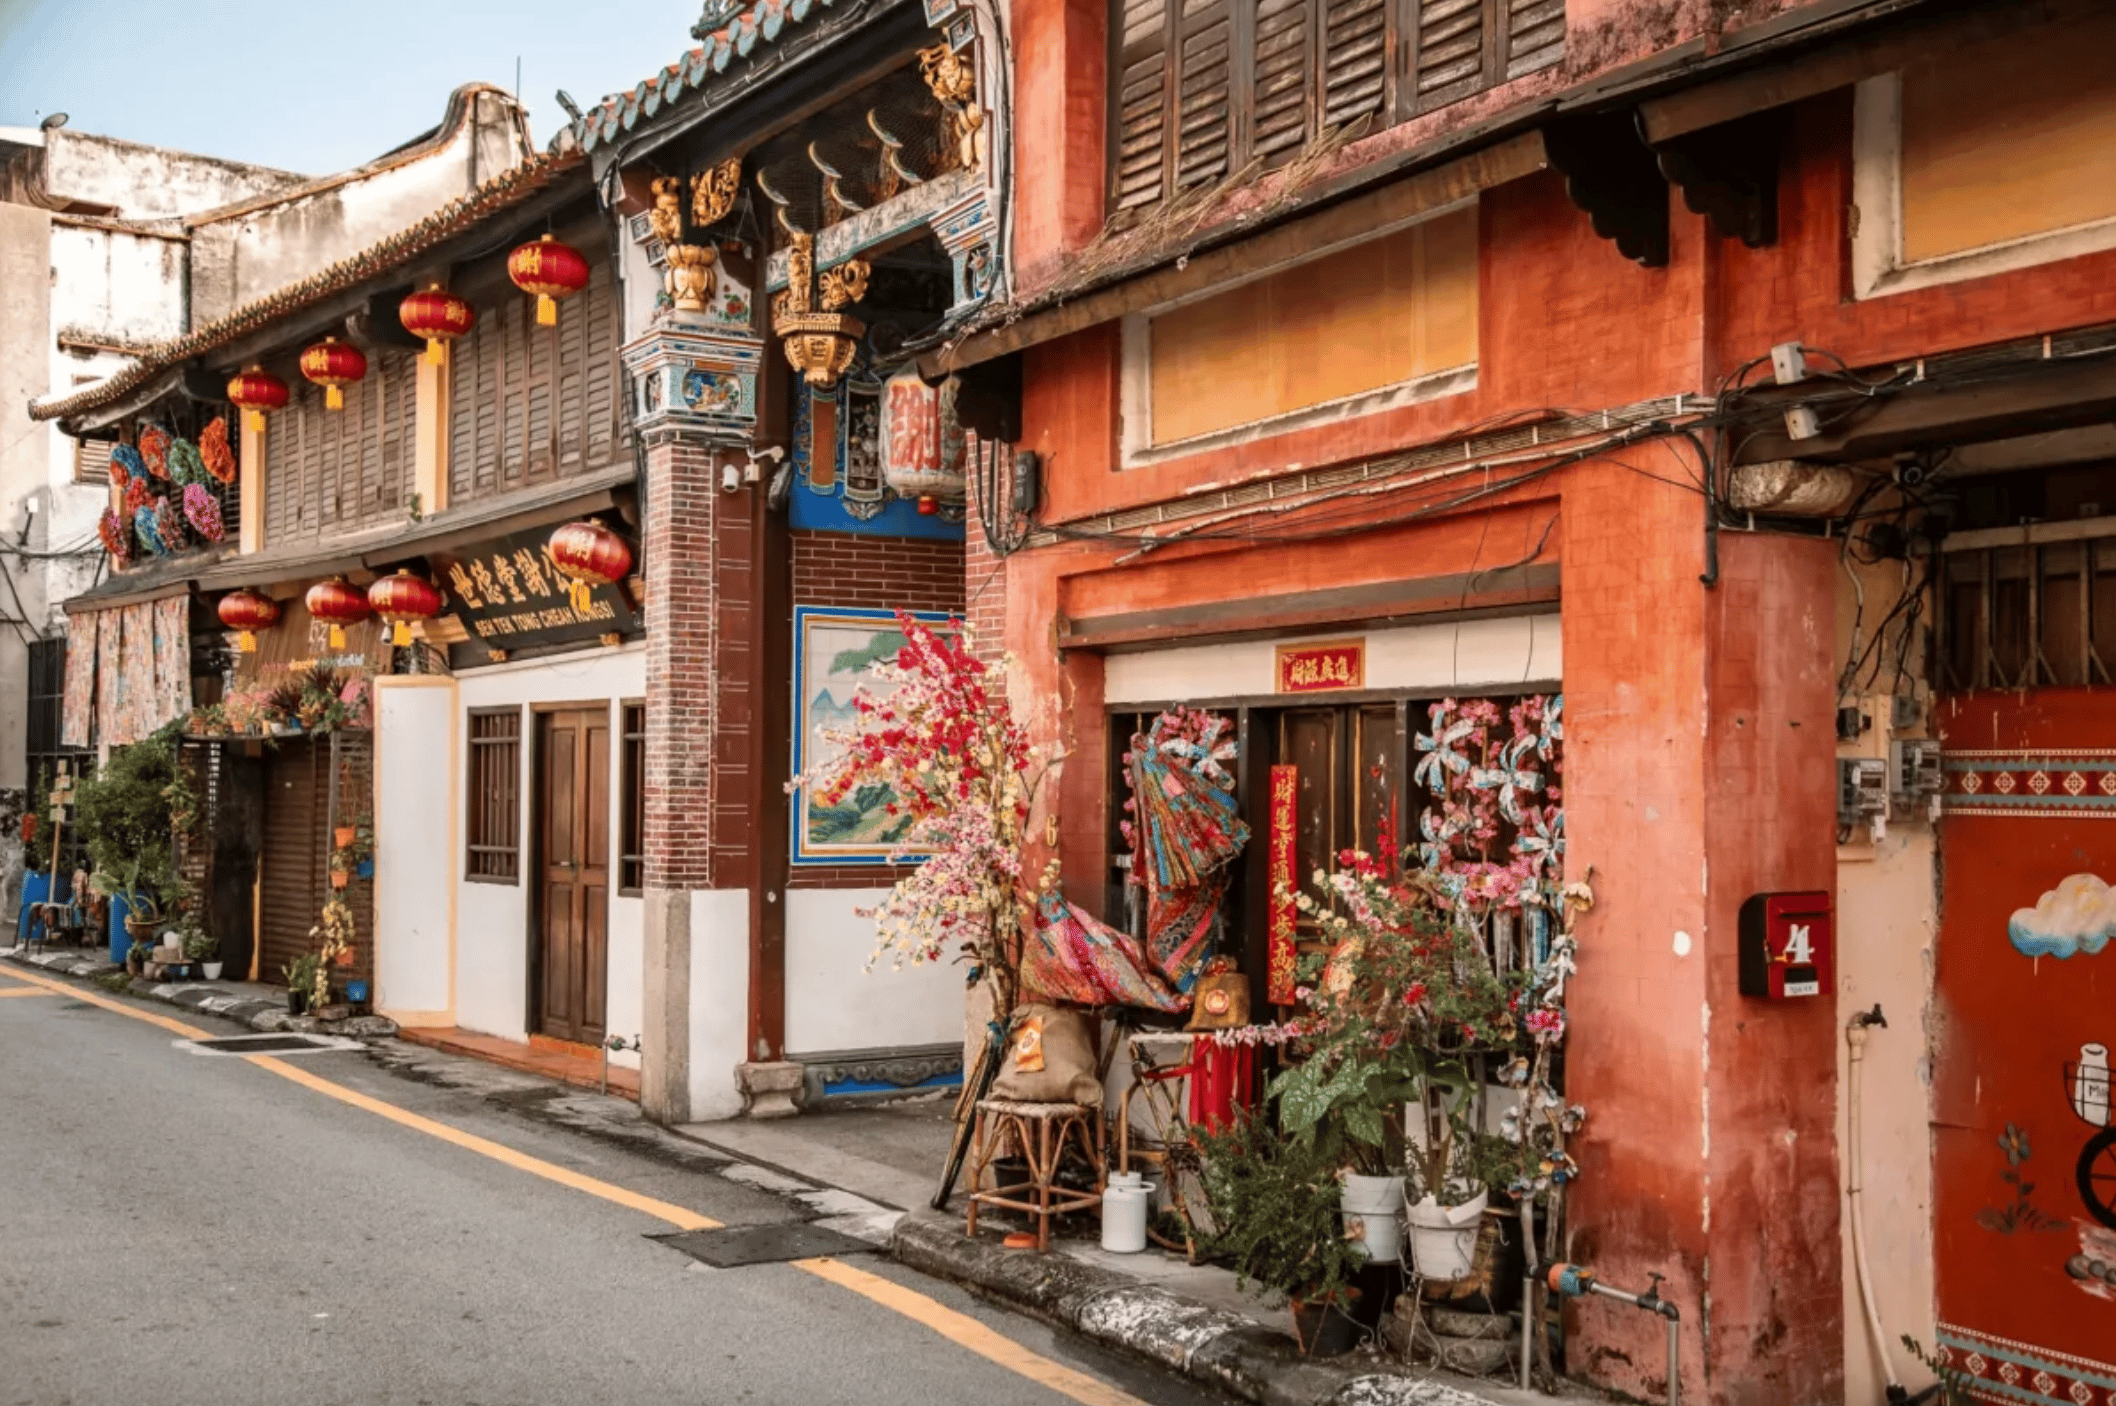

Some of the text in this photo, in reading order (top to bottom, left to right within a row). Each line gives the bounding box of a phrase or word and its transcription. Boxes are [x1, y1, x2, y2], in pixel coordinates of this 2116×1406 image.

[449, 544, 597, 609] 世德堂謝公
[511, 612, 542, 632] TONG
[538, 606, 577, 629] CHEAH
[1046, 813, 1058, 848] 6
[1783, 923, 1816, 964] 4
